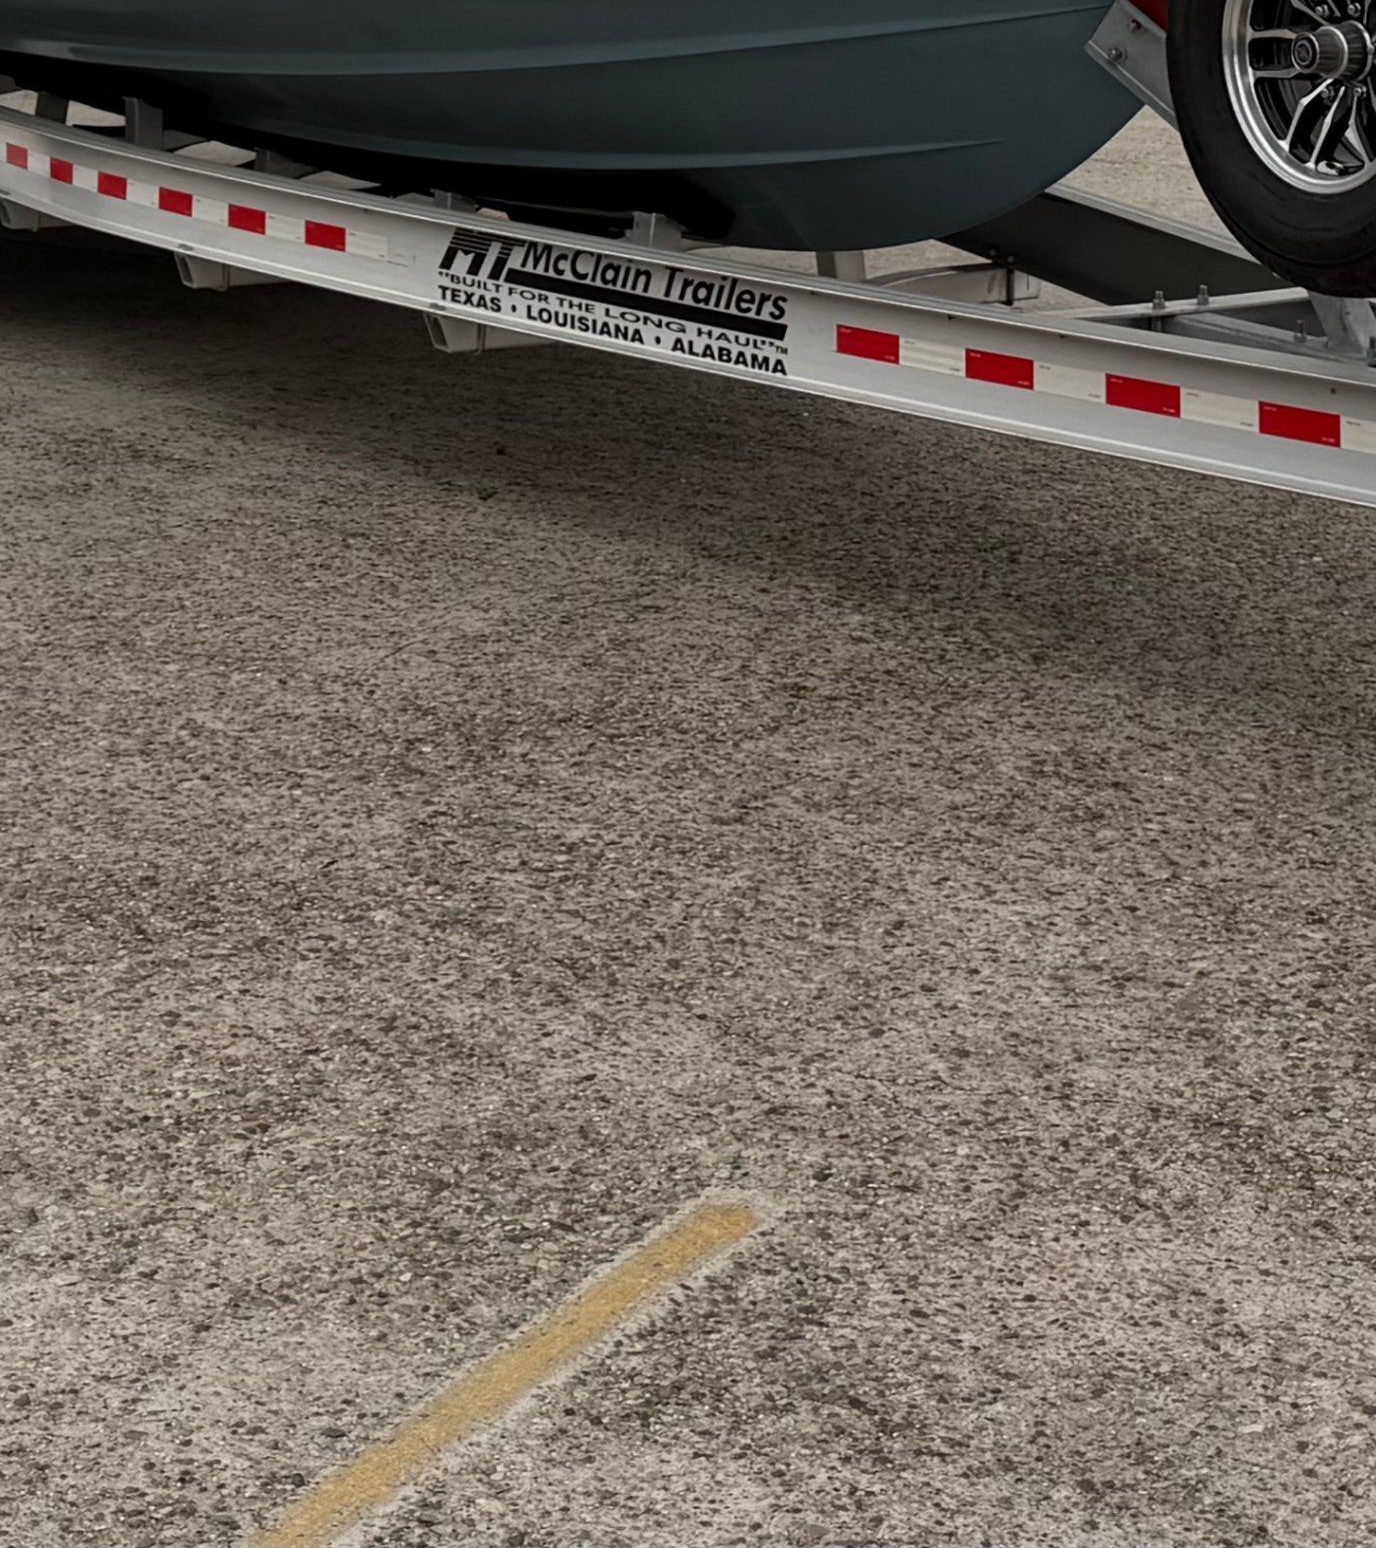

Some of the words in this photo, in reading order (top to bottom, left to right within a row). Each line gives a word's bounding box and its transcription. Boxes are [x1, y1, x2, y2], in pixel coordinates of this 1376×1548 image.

[508, 287, 550, 305] FOR
[556, 297, 596, 315] THE
[604, 307, 687, 333] LONG
[520, 240, 652, 295] McClain
[663, 266, 788, 321] Trailers
[438, 285, 502, 313] TEXAS
[526, 304, 644, 345] LOUISIANA
[671, 337, 787, 376] ALABAMA
